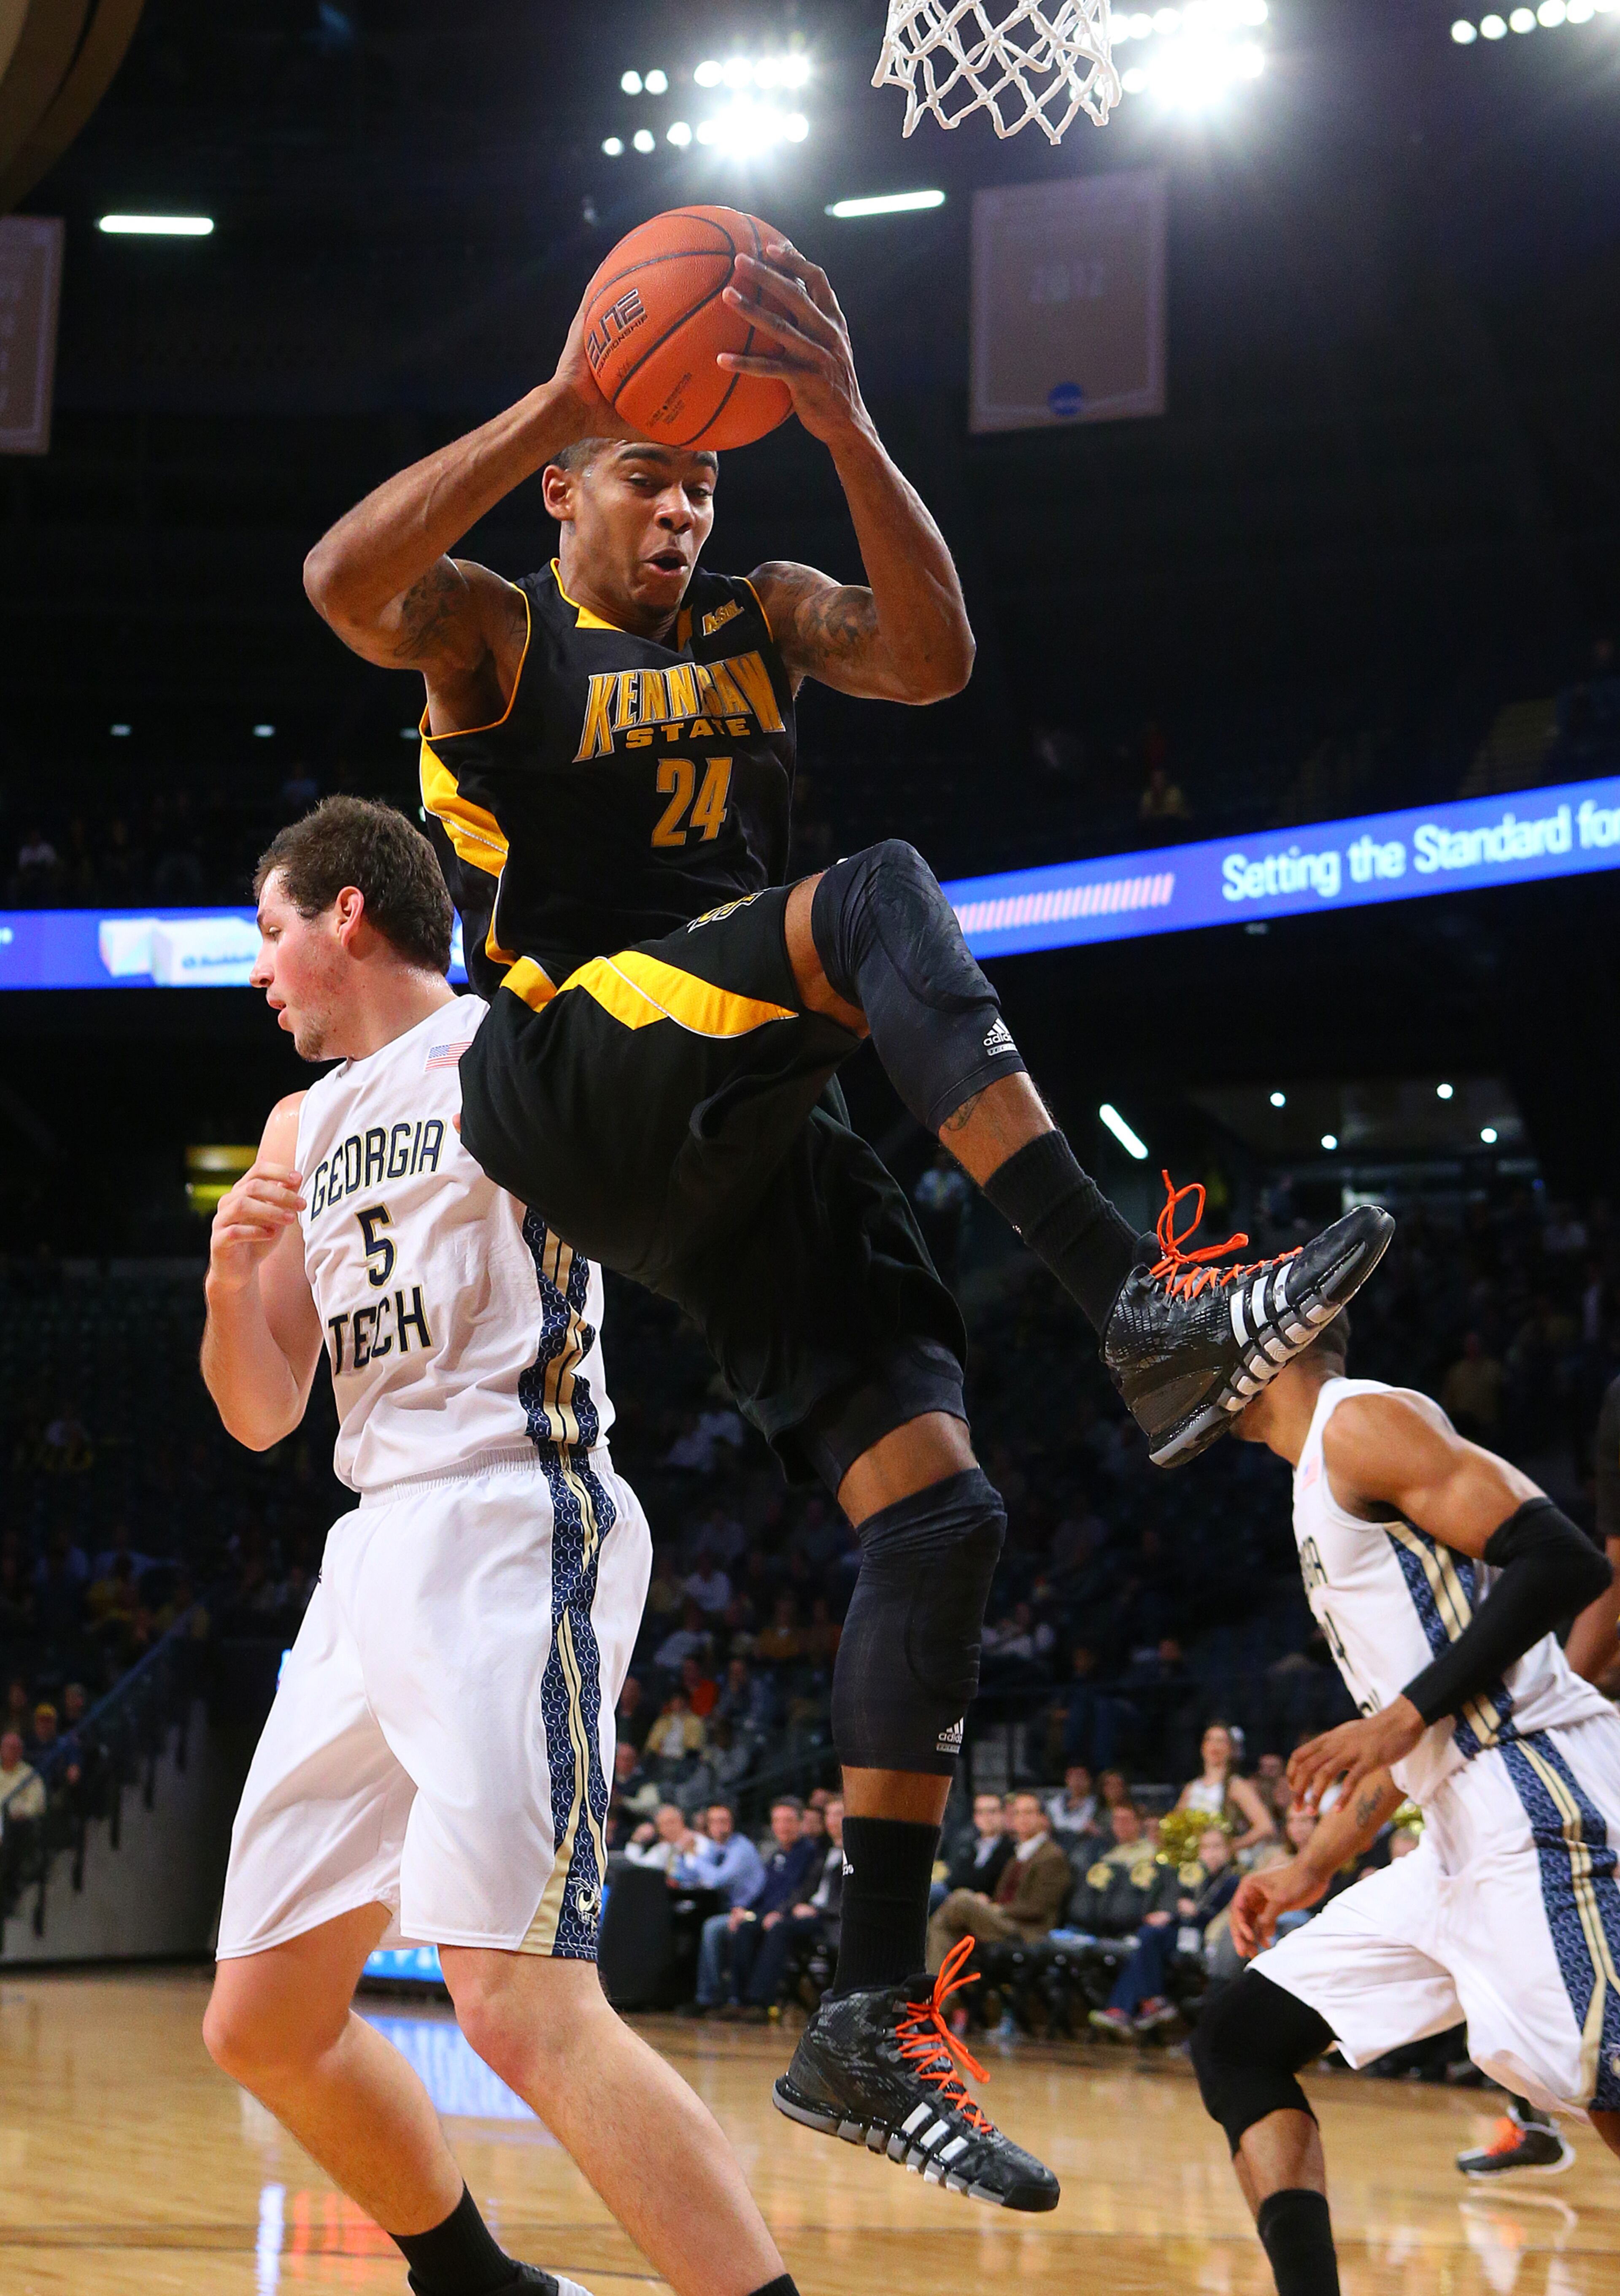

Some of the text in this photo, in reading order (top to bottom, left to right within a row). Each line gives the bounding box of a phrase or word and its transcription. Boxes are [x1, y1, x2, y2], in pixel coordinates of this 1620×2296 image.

[587, 287, 646, 370] ELITE
[596, 314, 648, 379] HAMPIONSHIP
[651, 757, 733, 848] 24
[1222, 845, 1342, 901] Setting
[1347, 836, 1407, 883] the
[1414, 803, 1573, 873] Standard
[983, 1032, 1014, 1047] adid
[310, 1119, 448, 1222] GEORGIA
[354, 1201, 397, 1290] 5
[327, 1285, 433, 1376] TECH
[938, 1732, 962, 1744] adid
